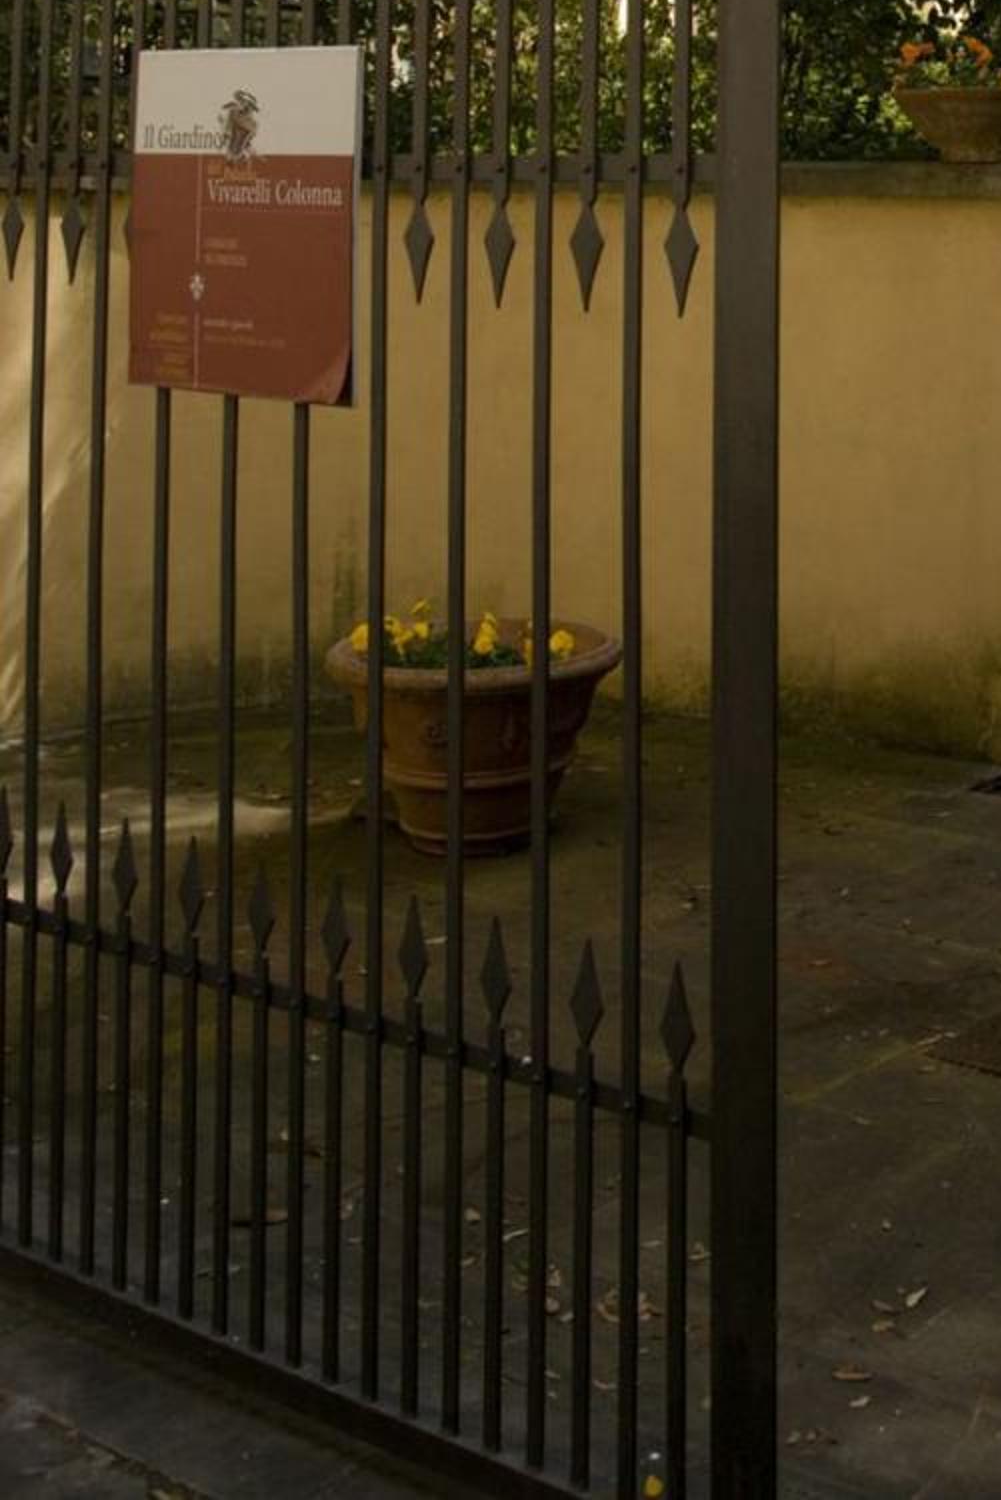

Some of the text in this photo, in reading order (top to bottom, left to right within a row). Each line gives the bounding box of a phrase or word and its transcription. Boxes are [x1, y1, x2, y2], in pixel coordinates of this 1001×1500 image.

[143, 125, 226, 150] Il Giardino
[207, 178, 343, 206] Vivarelli Colonna
